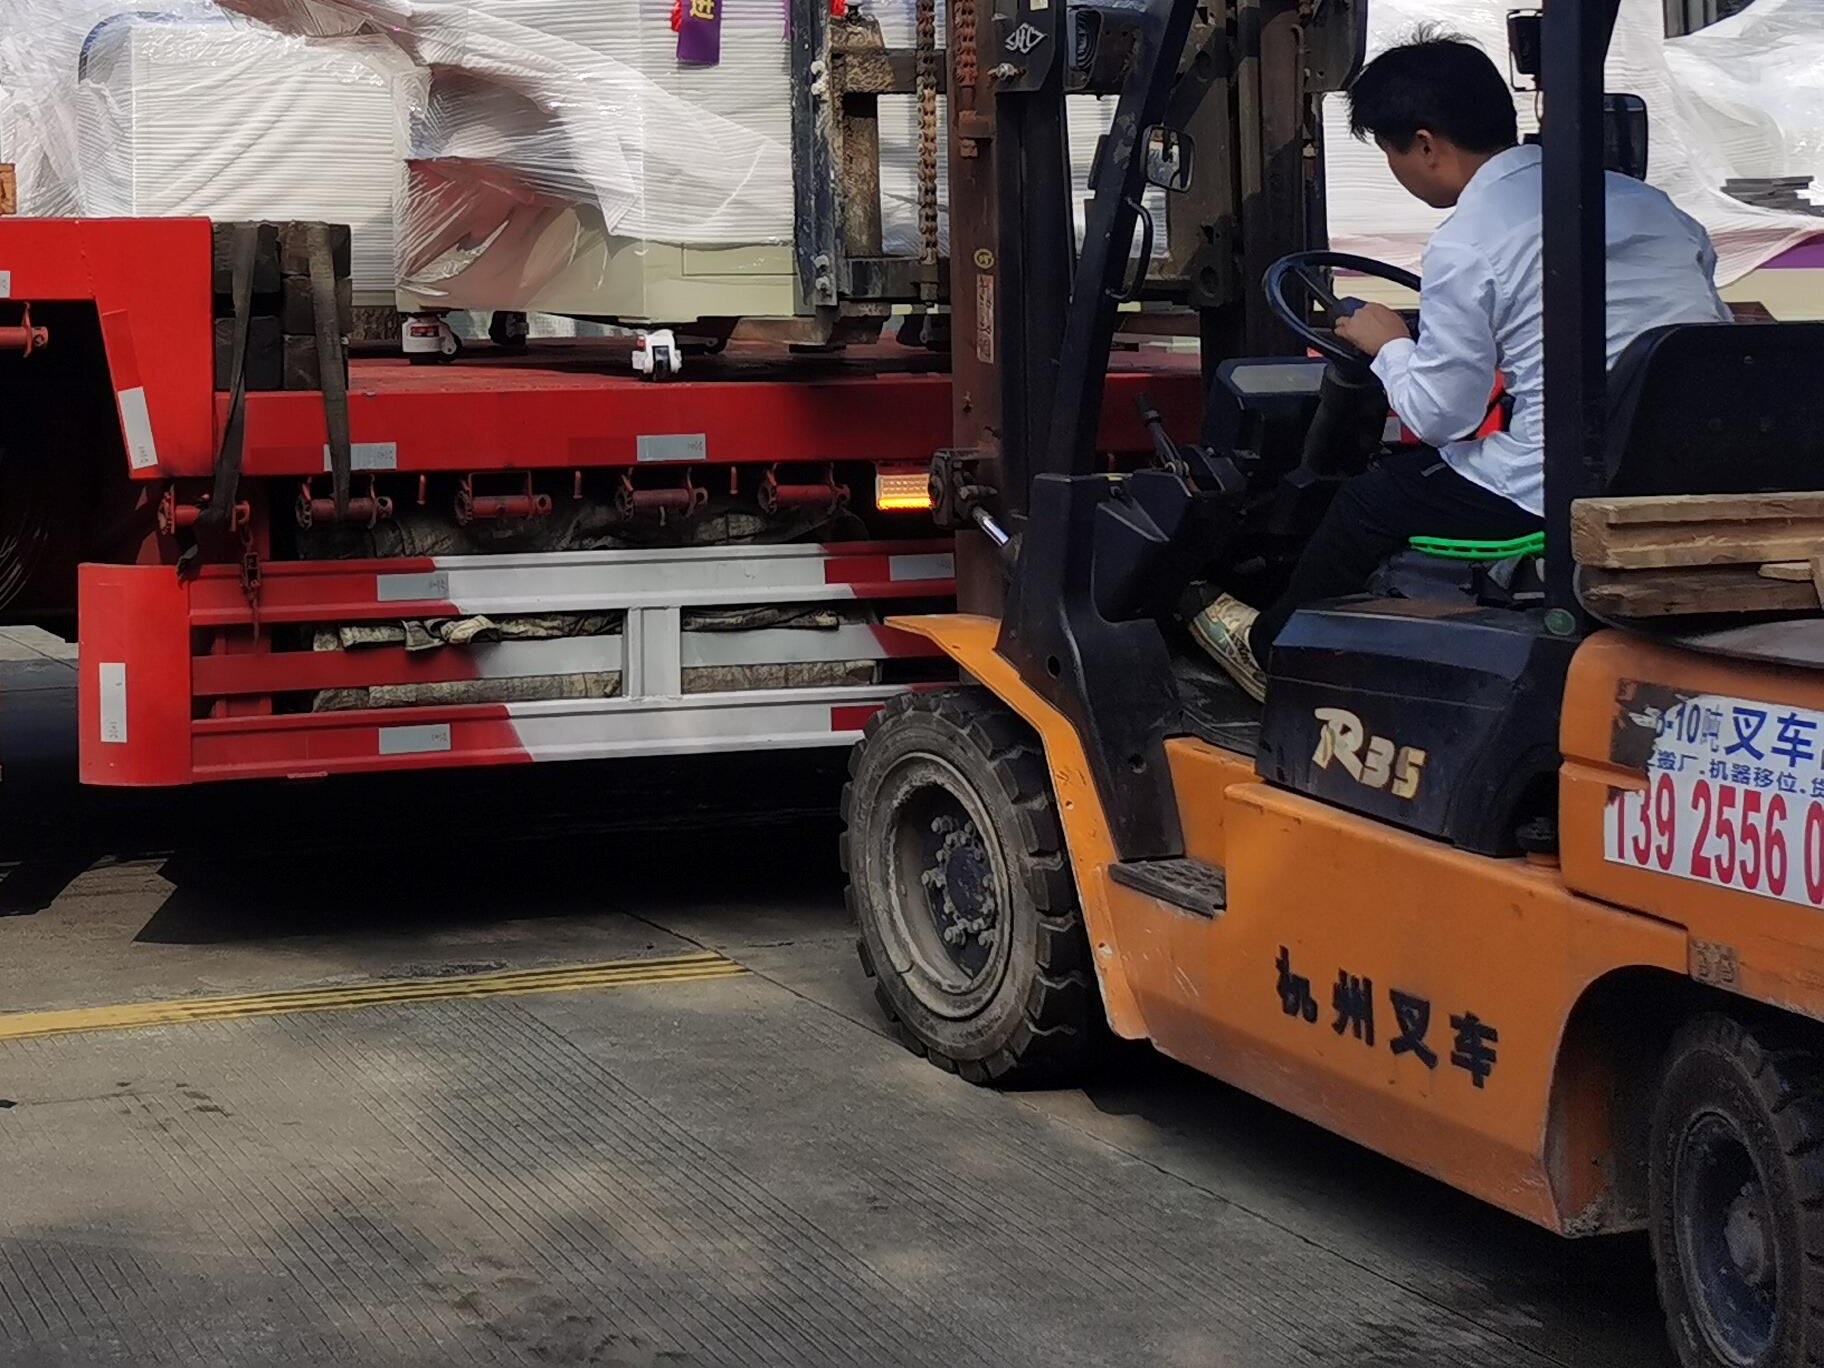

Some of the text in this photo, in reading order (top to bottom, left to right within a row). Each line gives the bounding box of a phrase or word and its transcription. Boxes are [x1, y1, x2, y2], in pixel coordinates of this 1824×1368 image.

[1311, 706, 1427, 800] R35
[1615, 773, 1676, 871] 139
[1689, 779, 1788, 897] 2556
